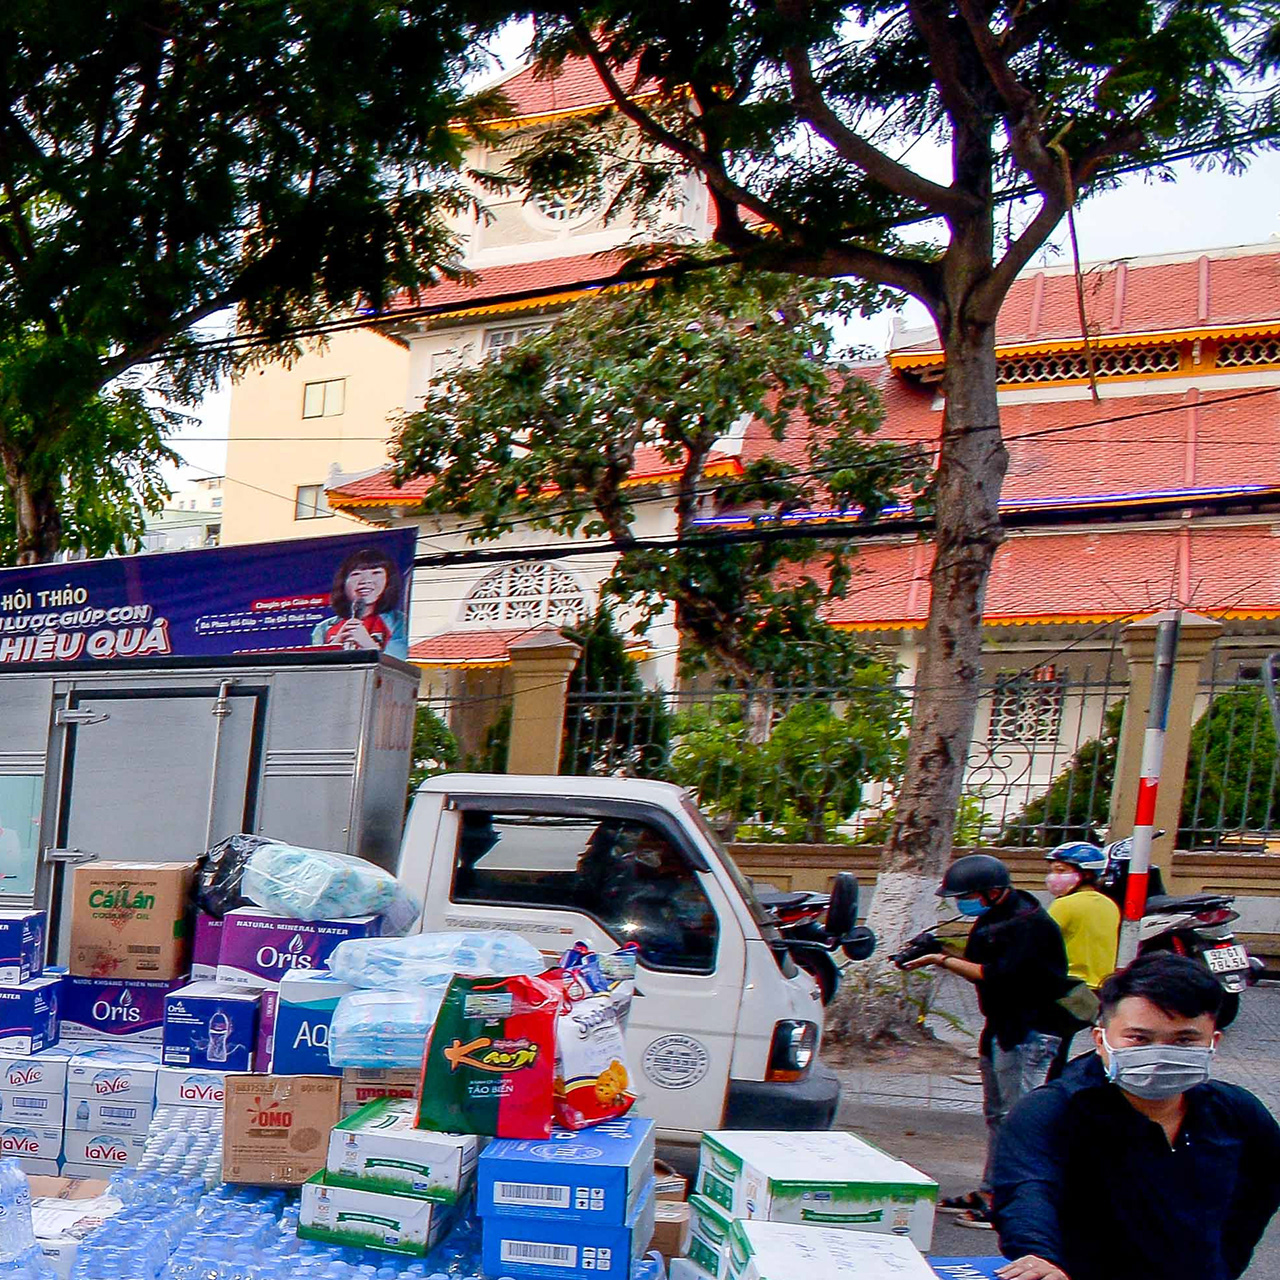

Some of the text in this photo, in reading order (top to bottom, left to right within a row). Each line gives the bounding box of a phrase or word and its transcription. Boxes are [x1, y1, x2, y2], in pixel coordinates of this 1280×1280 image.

[1, 589, 32, 614] HỘI
[3, 612, 60, 635] LƯỢC
[59, 606, 107, 627] GIÚP
[107, 604, 152, 625] CON
[86, 617, 172, 660] QUẢ
[236, 920, 349, 936] NATURAL MINERAL WATER
[255, 943, 313, 972] Oris
[92, 999, 141, 1022] Oris
[179, 1083, 224, 1101] laVie
[258, 1111, 293, 1127] OMO
[3, 1137, 40, 1153] aVie
[85, 1144, 128, 1162] laVie
